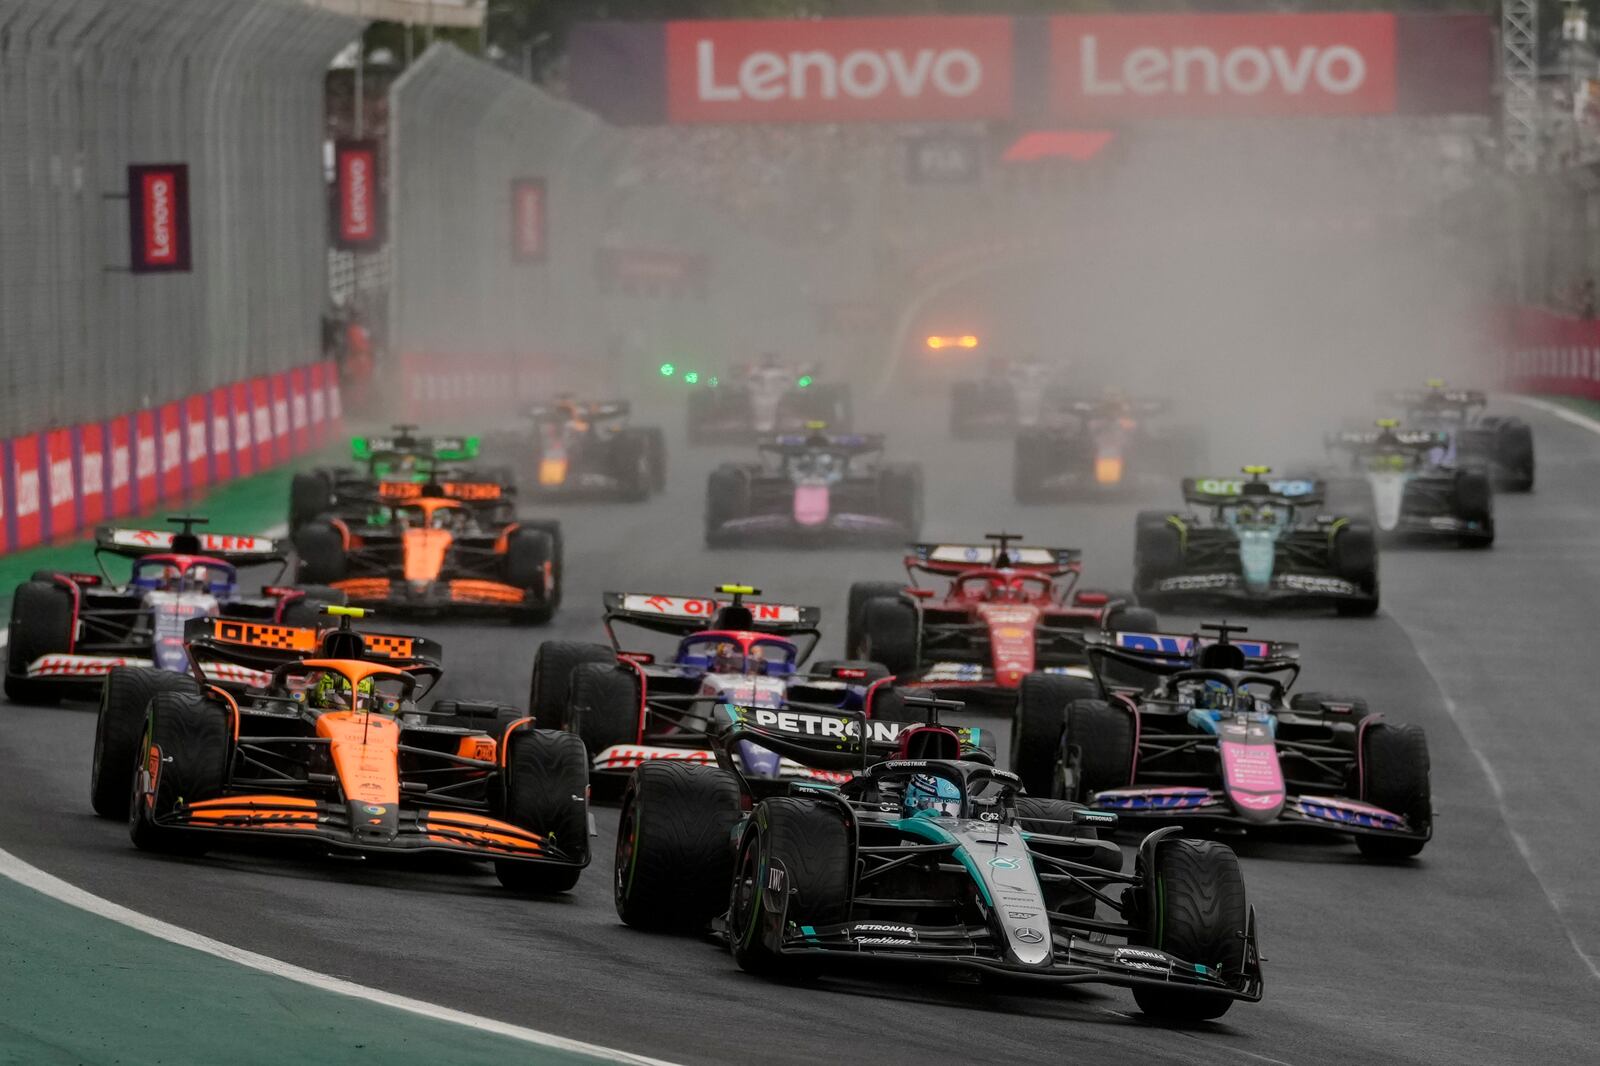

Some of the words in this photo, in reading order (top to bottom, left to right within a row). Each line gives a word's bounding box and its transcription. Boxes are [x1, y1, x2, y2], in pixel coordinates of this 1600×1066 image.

[698, 40, 981, 99] Lenovo
[1081, 36, 1365, 94] Lenovo
[349, 158, 367, 232] Lenovo
[151, 180, 169, 256] Lenovo
[980, 811, 999, 821] G42
[768, 867, 785, 892] IWC
[854, 924, 914, 934] PETRONAS
[1118, 947, 1167, 961] PETRONAS
